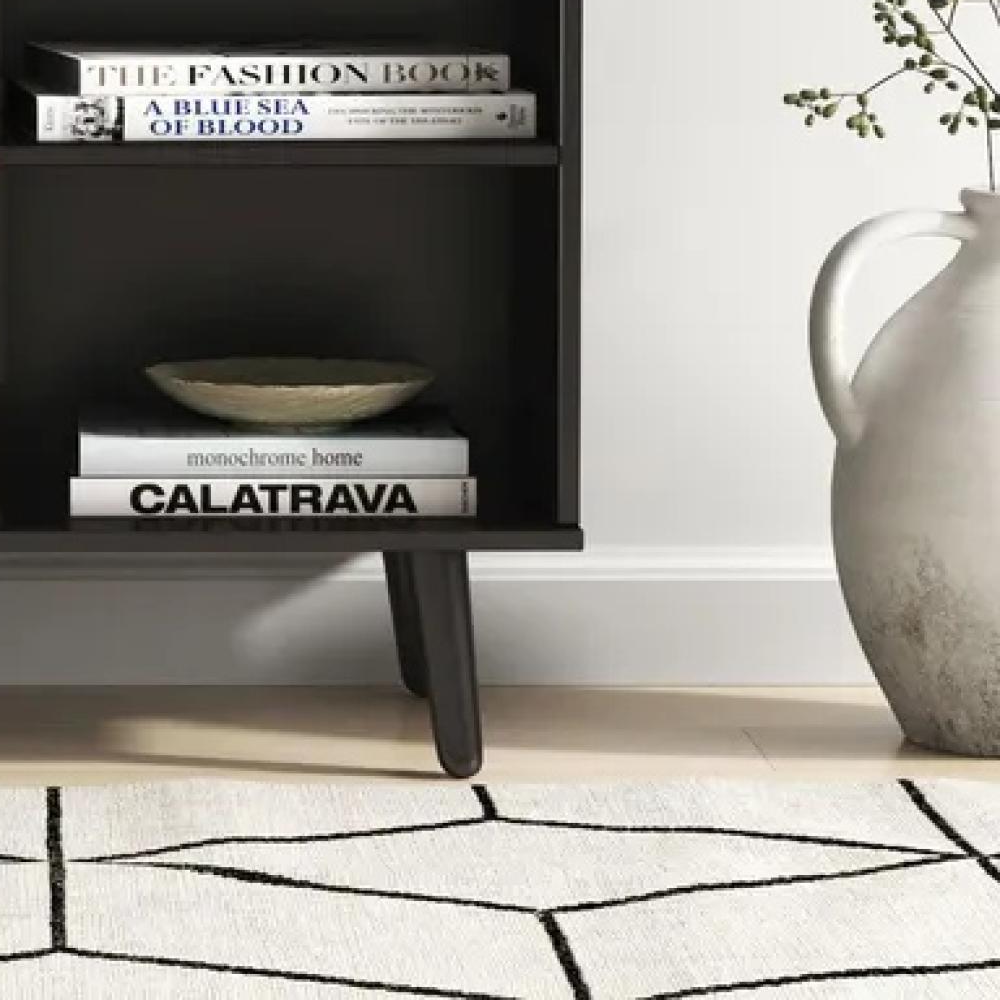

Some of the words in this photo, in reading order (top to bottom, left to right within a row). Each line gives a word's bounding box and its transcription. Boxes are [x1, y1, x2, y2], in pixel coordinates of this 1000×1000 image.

[87, 64, 176, 87] THE
[188, 62, 369, 86] FASHION
[383, 60, 500, 86] BOOK
[143, 98, 163, 116] A
[174, 98, 250, 116] BLUE
[257, 98, 310, 116] SEA
[151, 119, 189, 137] OF
[197, 119, 304, 136] BLOOD
[186, 449, 305, 467] monochrome
[312, 448, 363, 467] home
[129, 483, 419, 514] CALATRAVA
